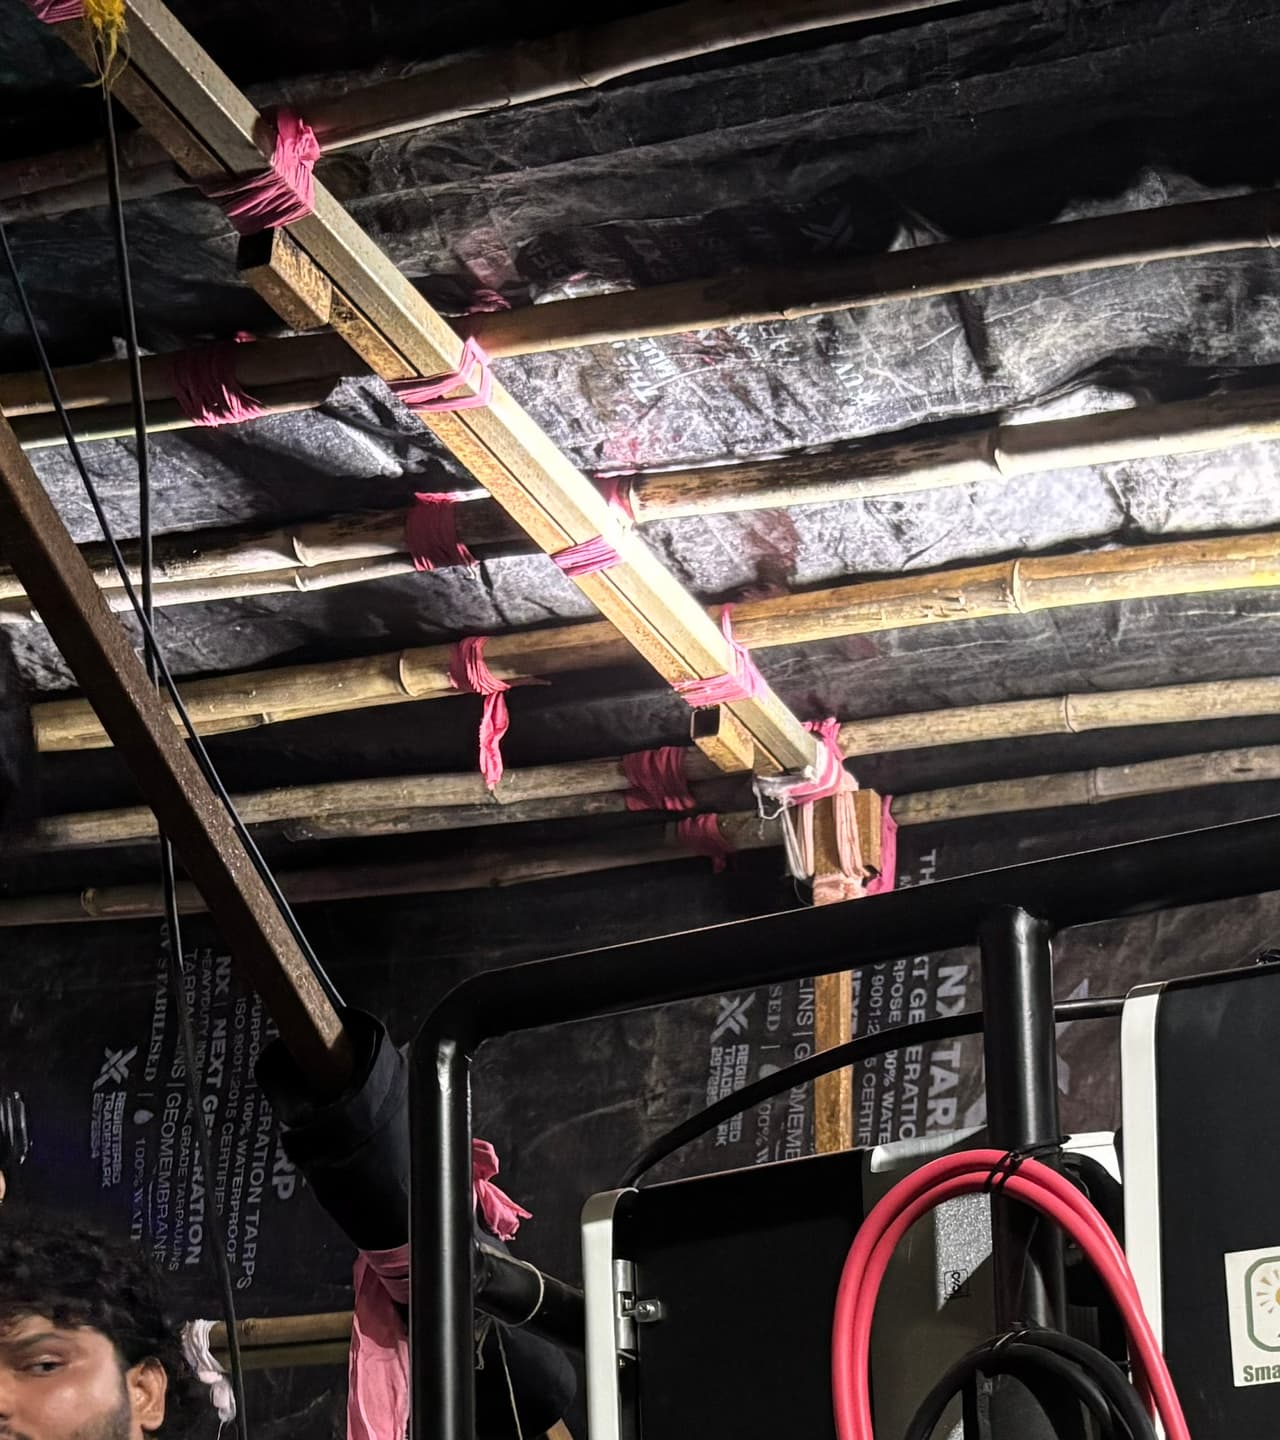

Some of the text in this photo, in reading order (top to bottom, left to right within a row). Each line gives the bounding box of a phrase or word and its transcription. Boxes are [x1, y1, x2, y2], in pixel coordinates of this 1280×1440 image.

[215, 955, 232, 997] NX
[206, 1016, 227, 1088] NEXT
[926, 1042, 961, 1136] TAR
[152, 1092, 182, 1262] GEOMEMBRANE
[226, 1139, 248, 1264] WATERPROOF
[236, 1210, 260, 1288] TARPS
